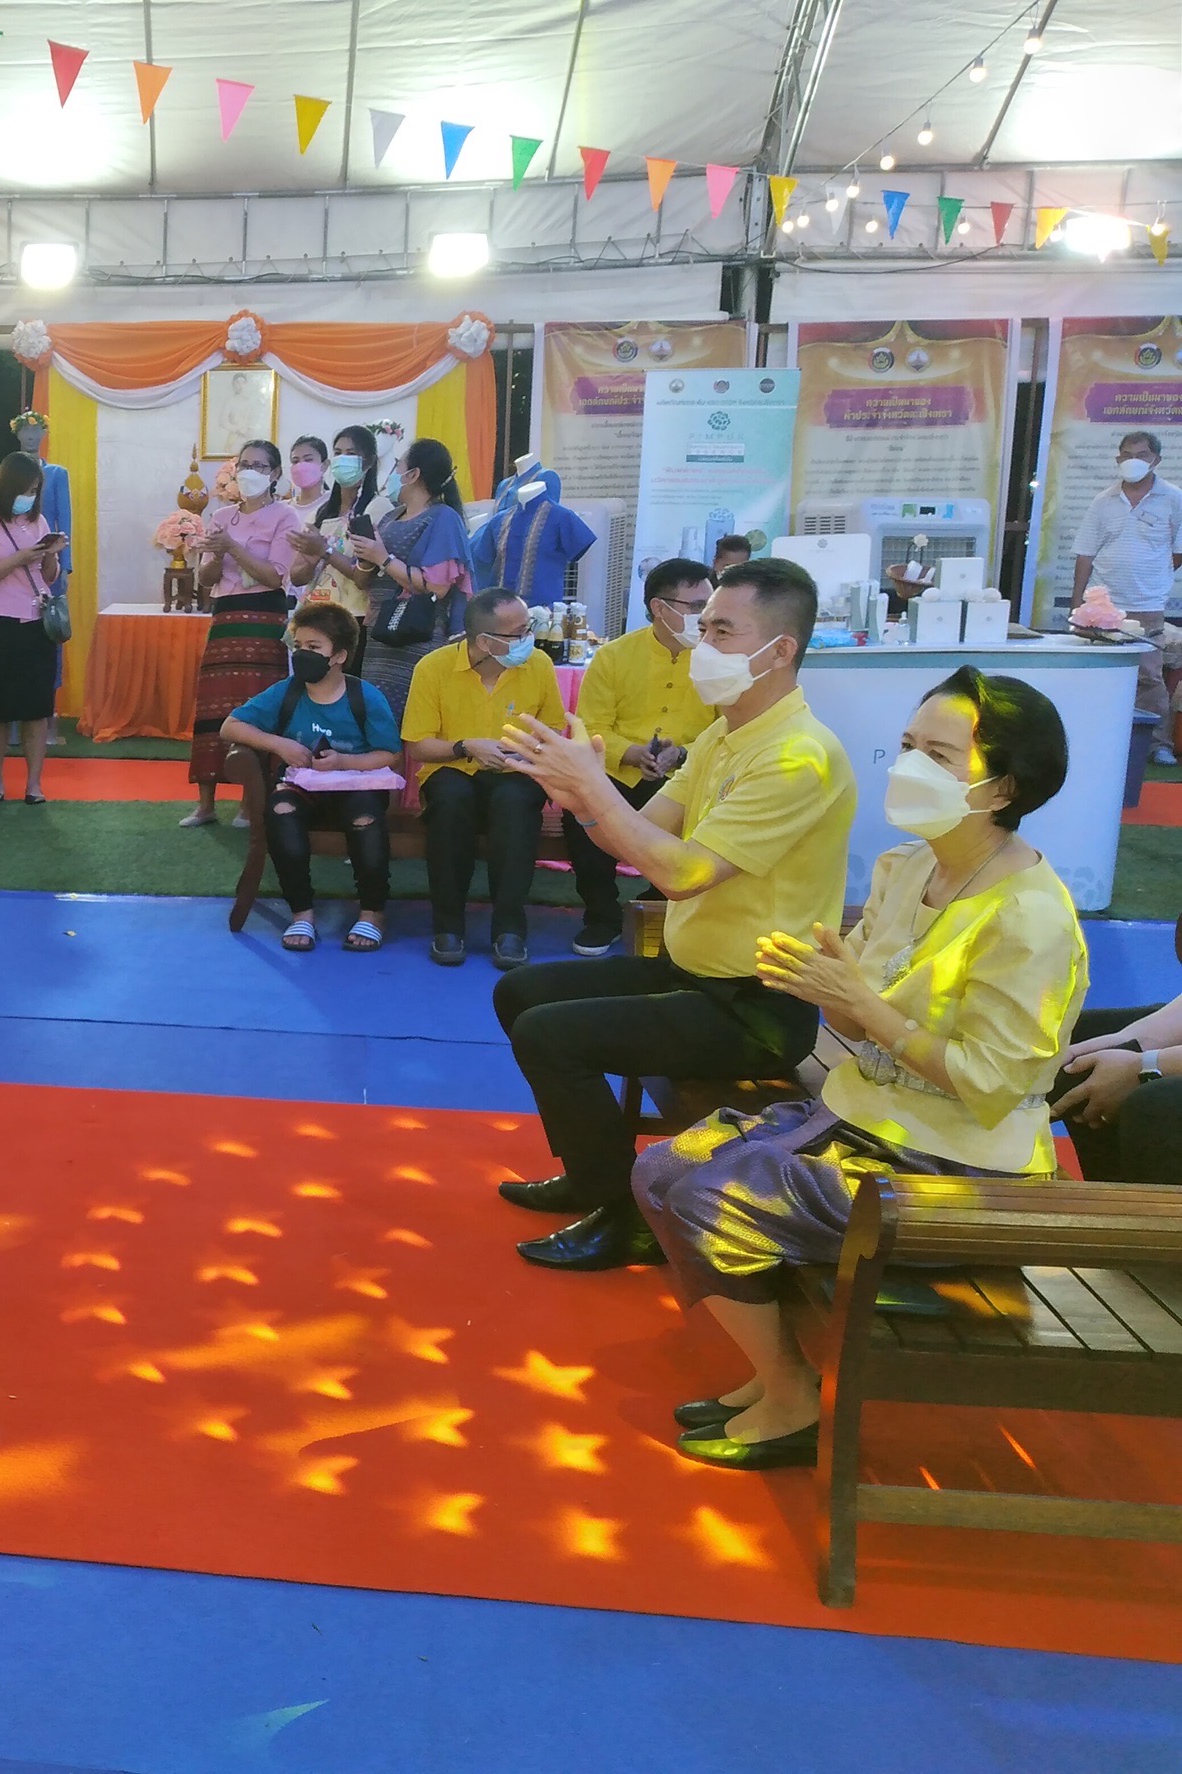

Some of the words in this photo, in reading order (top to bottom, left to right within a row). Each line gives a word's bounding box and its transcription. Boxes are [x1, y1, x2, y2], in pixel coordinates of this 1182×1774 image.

[579, 394, 644, 406] เอกลักษณ์ประจำ
